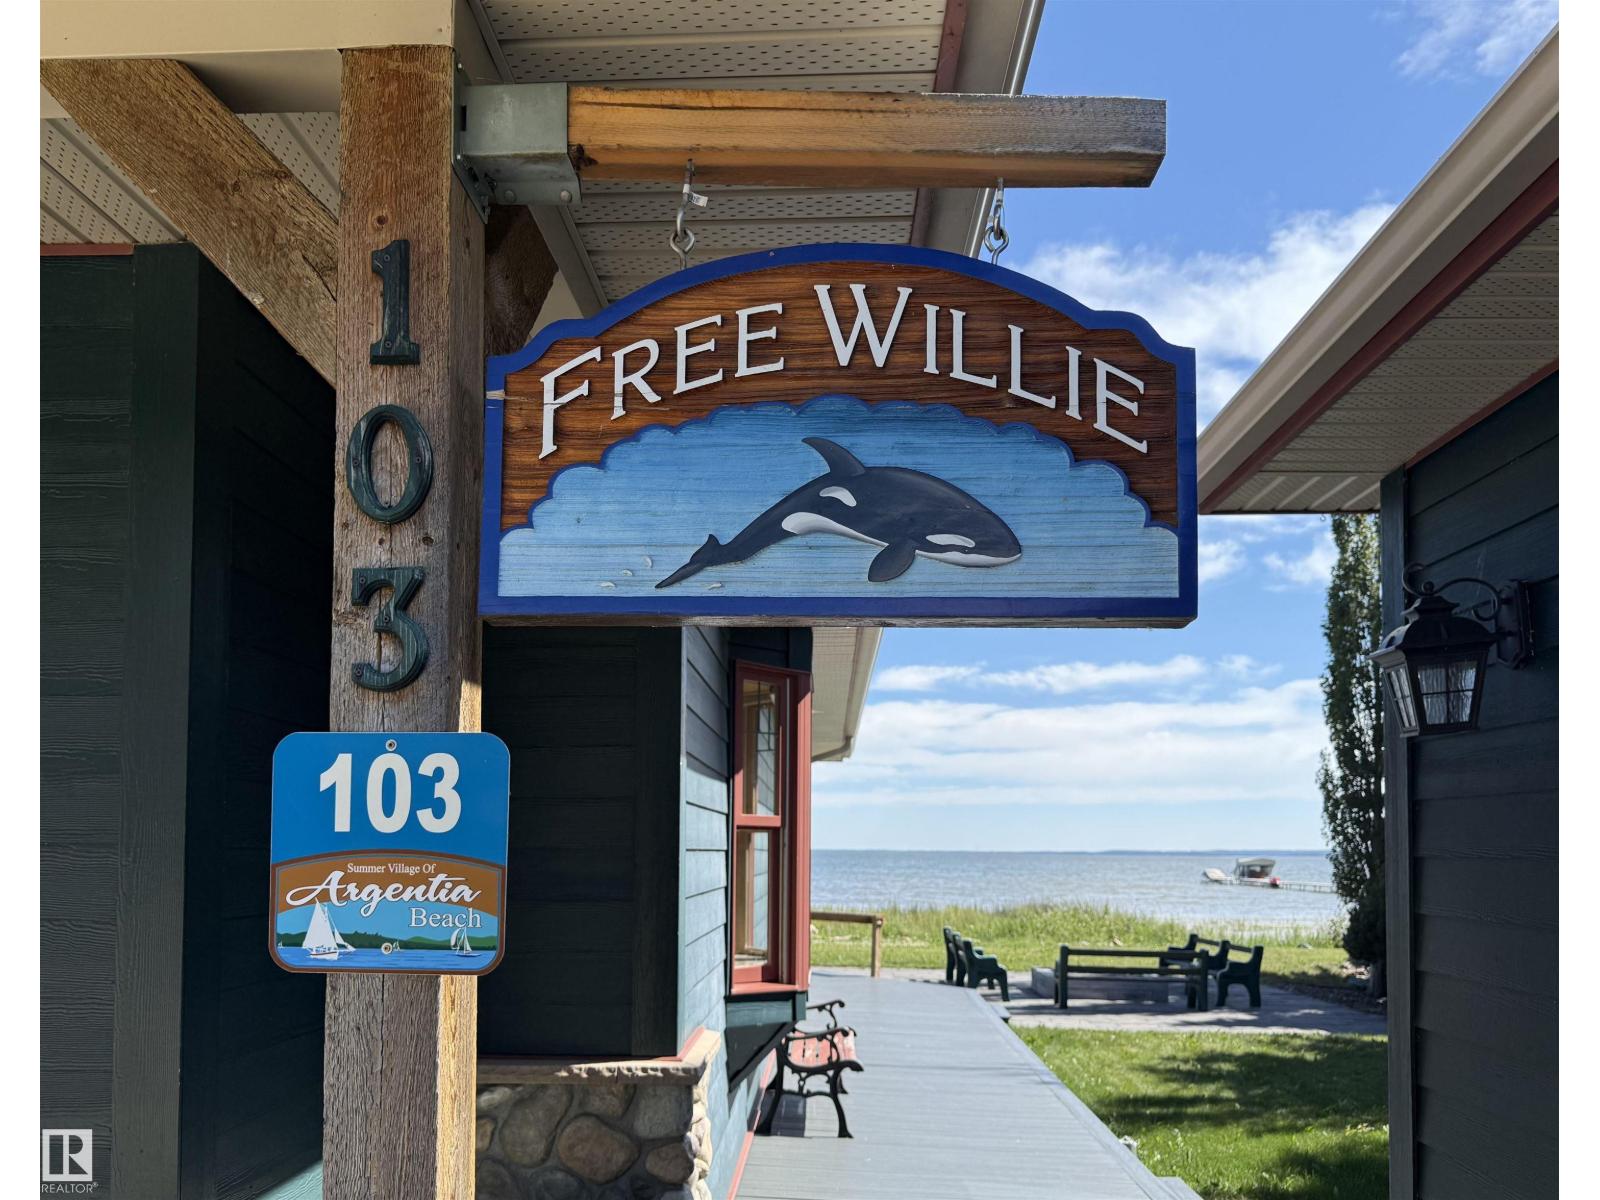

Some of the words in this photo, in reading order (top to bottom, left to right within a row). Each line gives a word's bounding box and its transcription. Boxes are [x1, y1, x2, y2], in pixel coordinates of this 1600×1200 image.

[539, 302, 785, 460] FREE
[814, 283, 1149, 454] WILLIE
[319, 752, 462, 834] 103
[347, 863, 385, 874] Summer
[388, 863, 421, 876] Village
[423, 863, 436, 874] Of
[285, 870, 482, 917] Argentia
[409, 907, 482, 929] Beach
